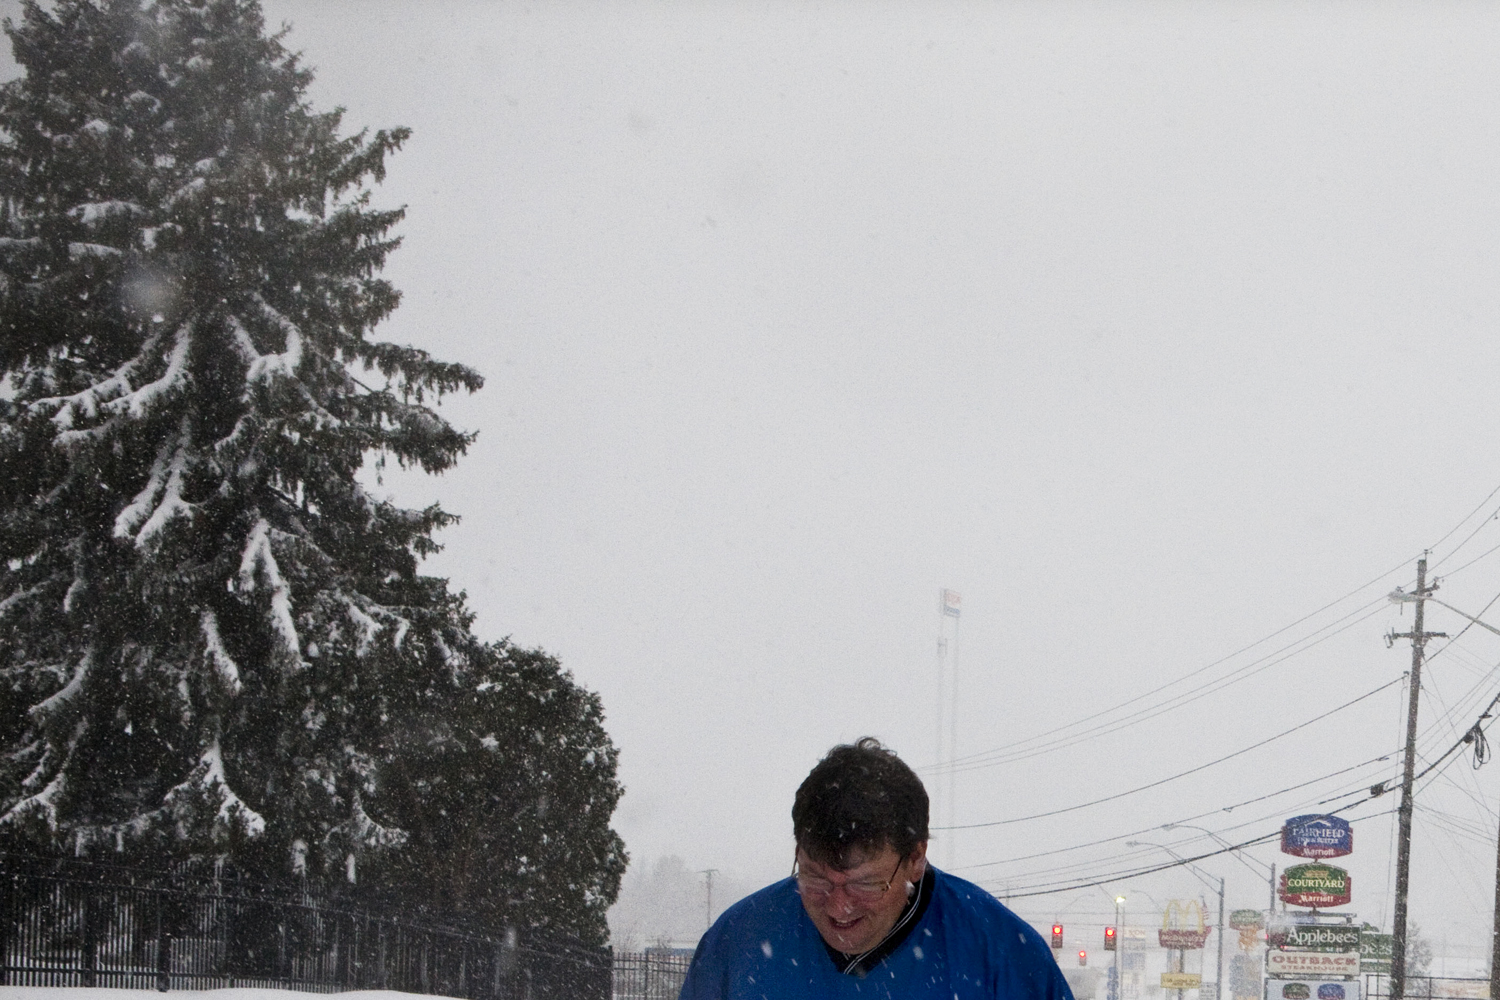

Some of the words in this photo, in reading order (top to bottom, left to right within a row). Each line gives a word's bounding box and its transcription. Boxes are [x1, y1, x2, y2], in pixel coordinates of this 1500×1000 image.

[1292, 827, 1345, 839] FAIRFIELD
[1303, 847, 1335, 857] Marriott
[1287, 878, 1345, 889] COURTYARD
[1300, 893, 1334, 903] Marriott
[1287, 925, 1358, 946] Applebee's
[1271, 955, 1357, 966] OUTBACK
